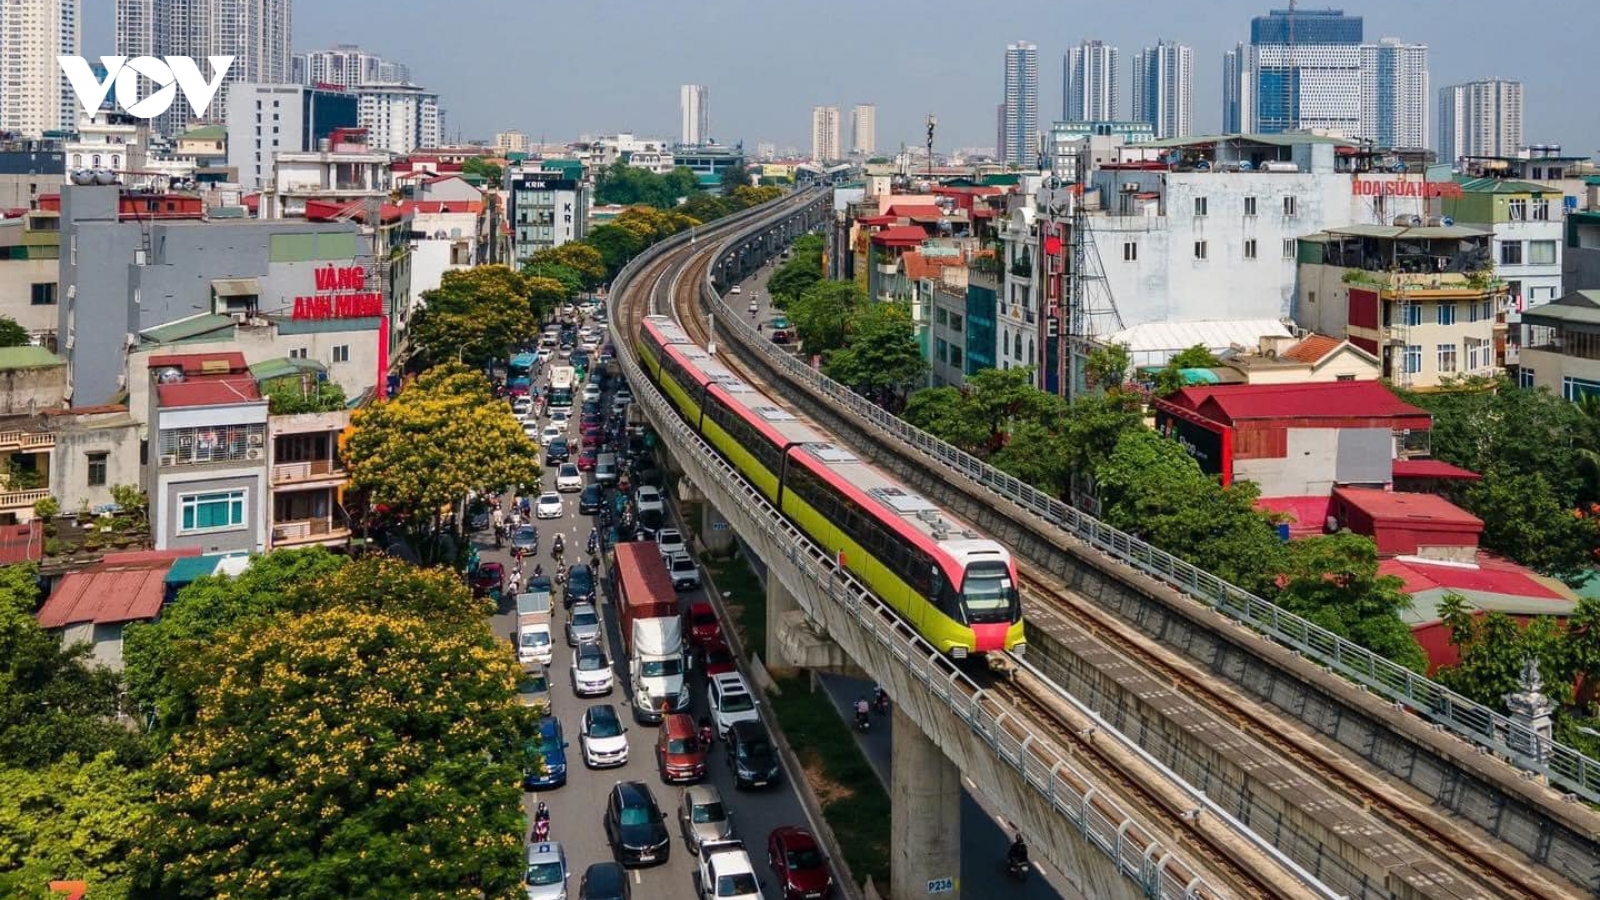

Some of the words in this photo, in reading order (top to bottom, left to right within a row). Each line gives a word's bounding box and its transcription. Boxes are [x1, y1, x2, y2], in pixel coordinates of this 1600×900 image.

[1352, 181, 1382, 196] HOA
[314, 263, 364, 292] VÀNG
[292, 296, 332, 320] ANH
[929, 879, 952, 892] P236
